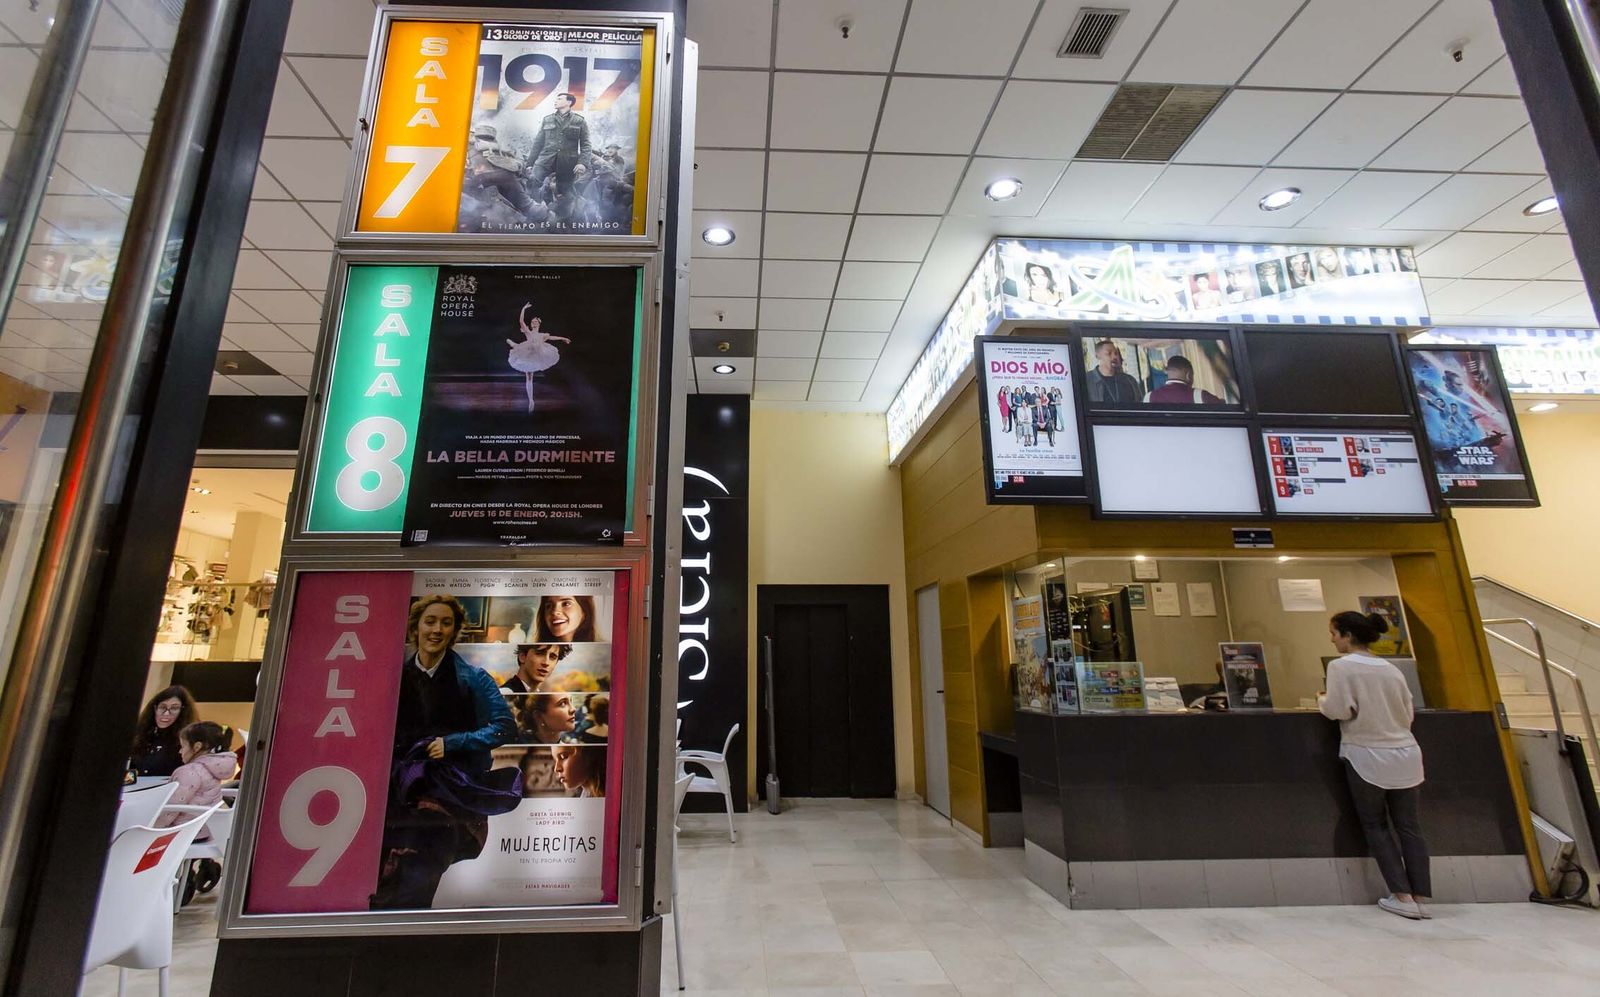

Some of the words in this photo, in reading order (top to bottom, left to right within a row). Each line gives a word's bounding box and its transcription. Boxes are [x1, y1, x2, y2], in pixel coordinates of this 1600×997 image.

[405, 36, 449, 128] SALA
[477, 52, 642, 110] 1917
[372, 145, 452, 218] 7
[364, 284, 412, 397] SALA
[991, 361, 1028, 373] DIOS
[1034, 359, 1068, 376] MÍO,
[335, 416, 407, 512] 8
[427, 450, 449, 463] LA
[454, 450, 509, 463] BELLA
[514, 450, 616, 463] DURMIENTE
[1458, 457, 1495, 465] WARS
[314, 595, 370, 737] SALA
[279, 765, 367, 887] 9
[500, 835, 597, 854] MUJERCITAS
